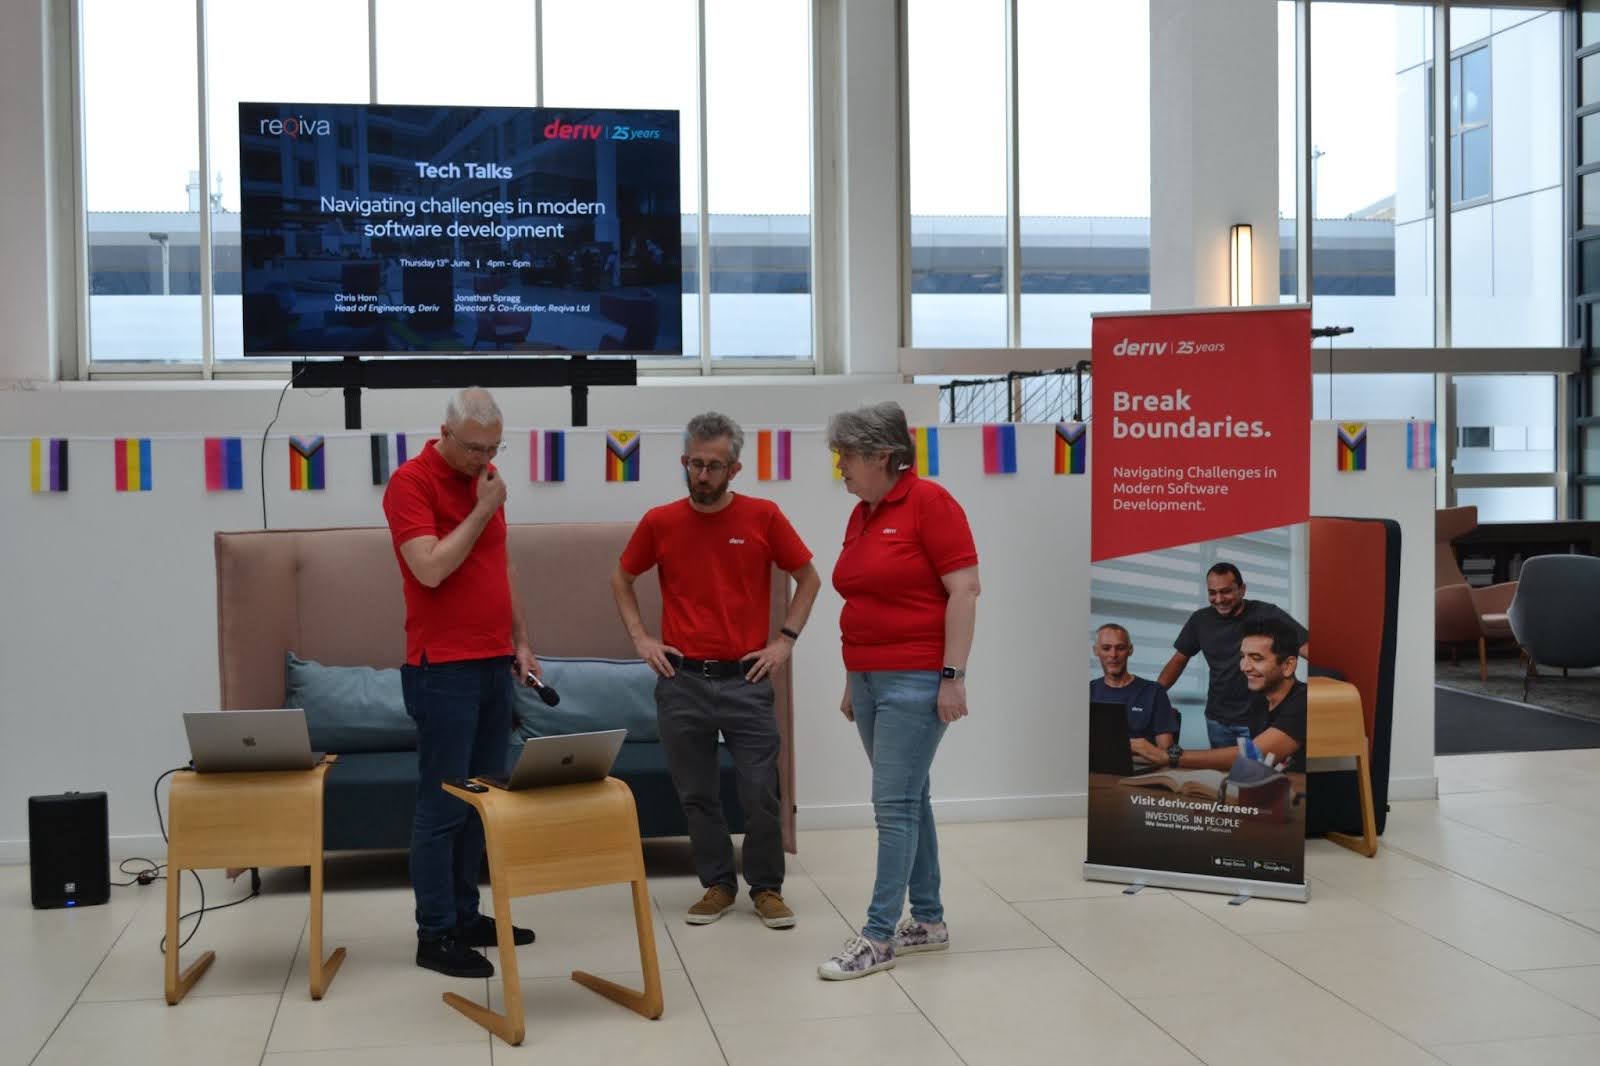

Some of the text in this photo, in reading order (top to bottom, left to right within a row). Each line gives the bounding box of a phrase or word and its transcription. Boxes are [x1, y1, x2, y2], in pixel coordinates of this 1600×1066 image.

[543, 118, 661, 141] deriv 25 years
[415, 162, 513, 179] Tech Talks
[320, 197, 605, 218] Navigating challenges in modern
[364, 220, 564, 241] software development
[400, 259, 435, 269] Thursday
[450, 259, 471, 268] June
[487, 259, 505, 269] 4pm
[512, 259, 531, 269] 6pm
[334, 294, 377, 302] Chris Horn
[455, 294, 521, 304] Jonathan Spragg
[334, 304, 440, 314] Head of Engineering, Deriv
[454, 304, 590, 314] Director & Co-Founder, Reqiva Ltd
[1113, 338, 1225, 356] deriv 25 years
[1113, 389, 1191, 412] Break
[1113, 416, 1271, 439] boundaries.
[1113, 466, 1277, 480] Navigating Challenges in
[1113, 482, 1229, 495] Modern Software
[1113, 498, 1206, 512] Development.
[1130, 795, 1156, 806] Visit
[1158, 797, 1259, 815] deriv.com/careers
[1145, 811, 1240, 828] INVESTORS IN PEOPLE
